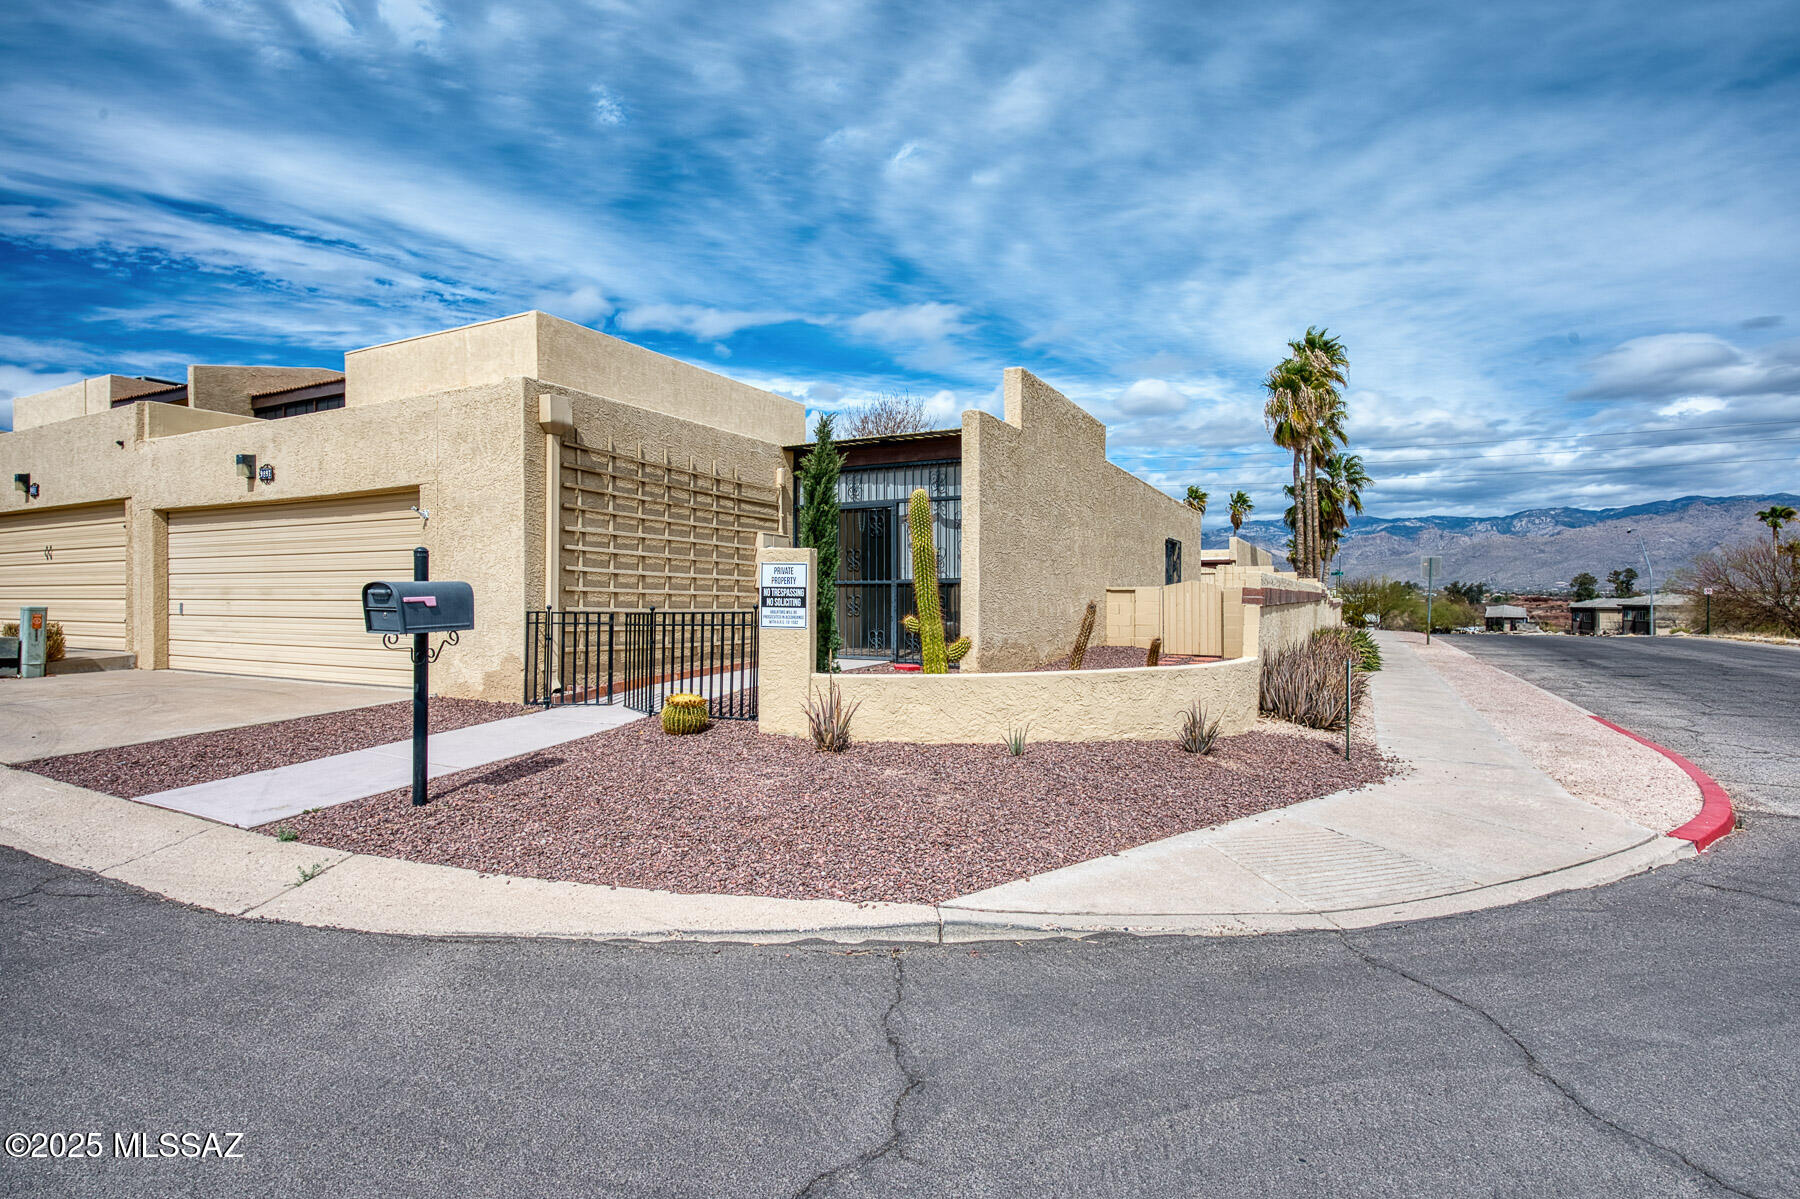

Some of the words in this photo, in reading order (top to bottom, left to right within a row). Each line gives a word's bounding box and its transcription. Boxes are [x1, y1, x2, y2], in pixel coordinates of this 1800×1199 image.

[774, 567, 794, 575] PRIVATE
[764, 588, 770, 596] NO
[771, 588, 804, 597] TRESPASSING
[766, 598, 774, 606] NO
[775, 598, 801, 606] SOLICITING
